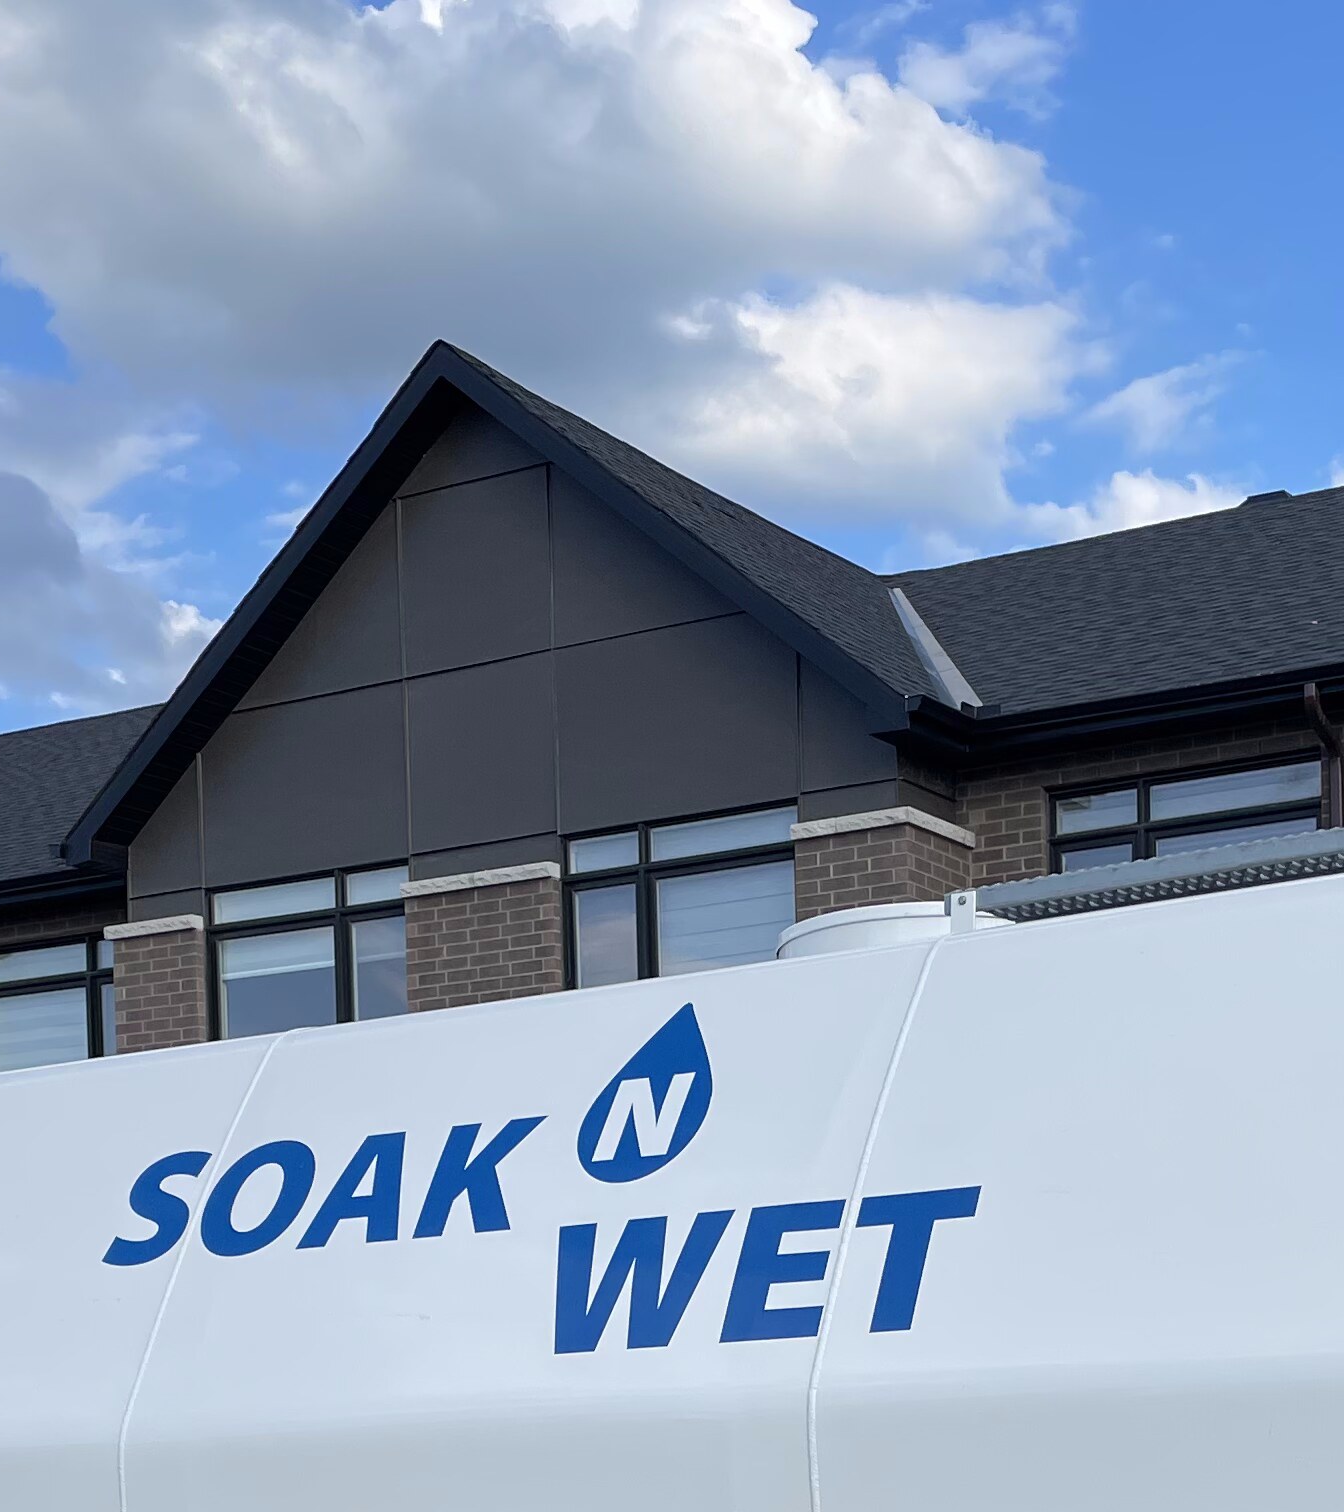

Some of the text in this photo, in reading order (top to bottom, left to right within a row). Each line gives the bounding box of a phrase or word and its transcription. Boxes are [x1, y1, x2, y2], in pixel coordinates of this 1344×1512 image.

[102, 1071, 697, 1267] SOAK N
[554, 1185, 982, 1355] WET
